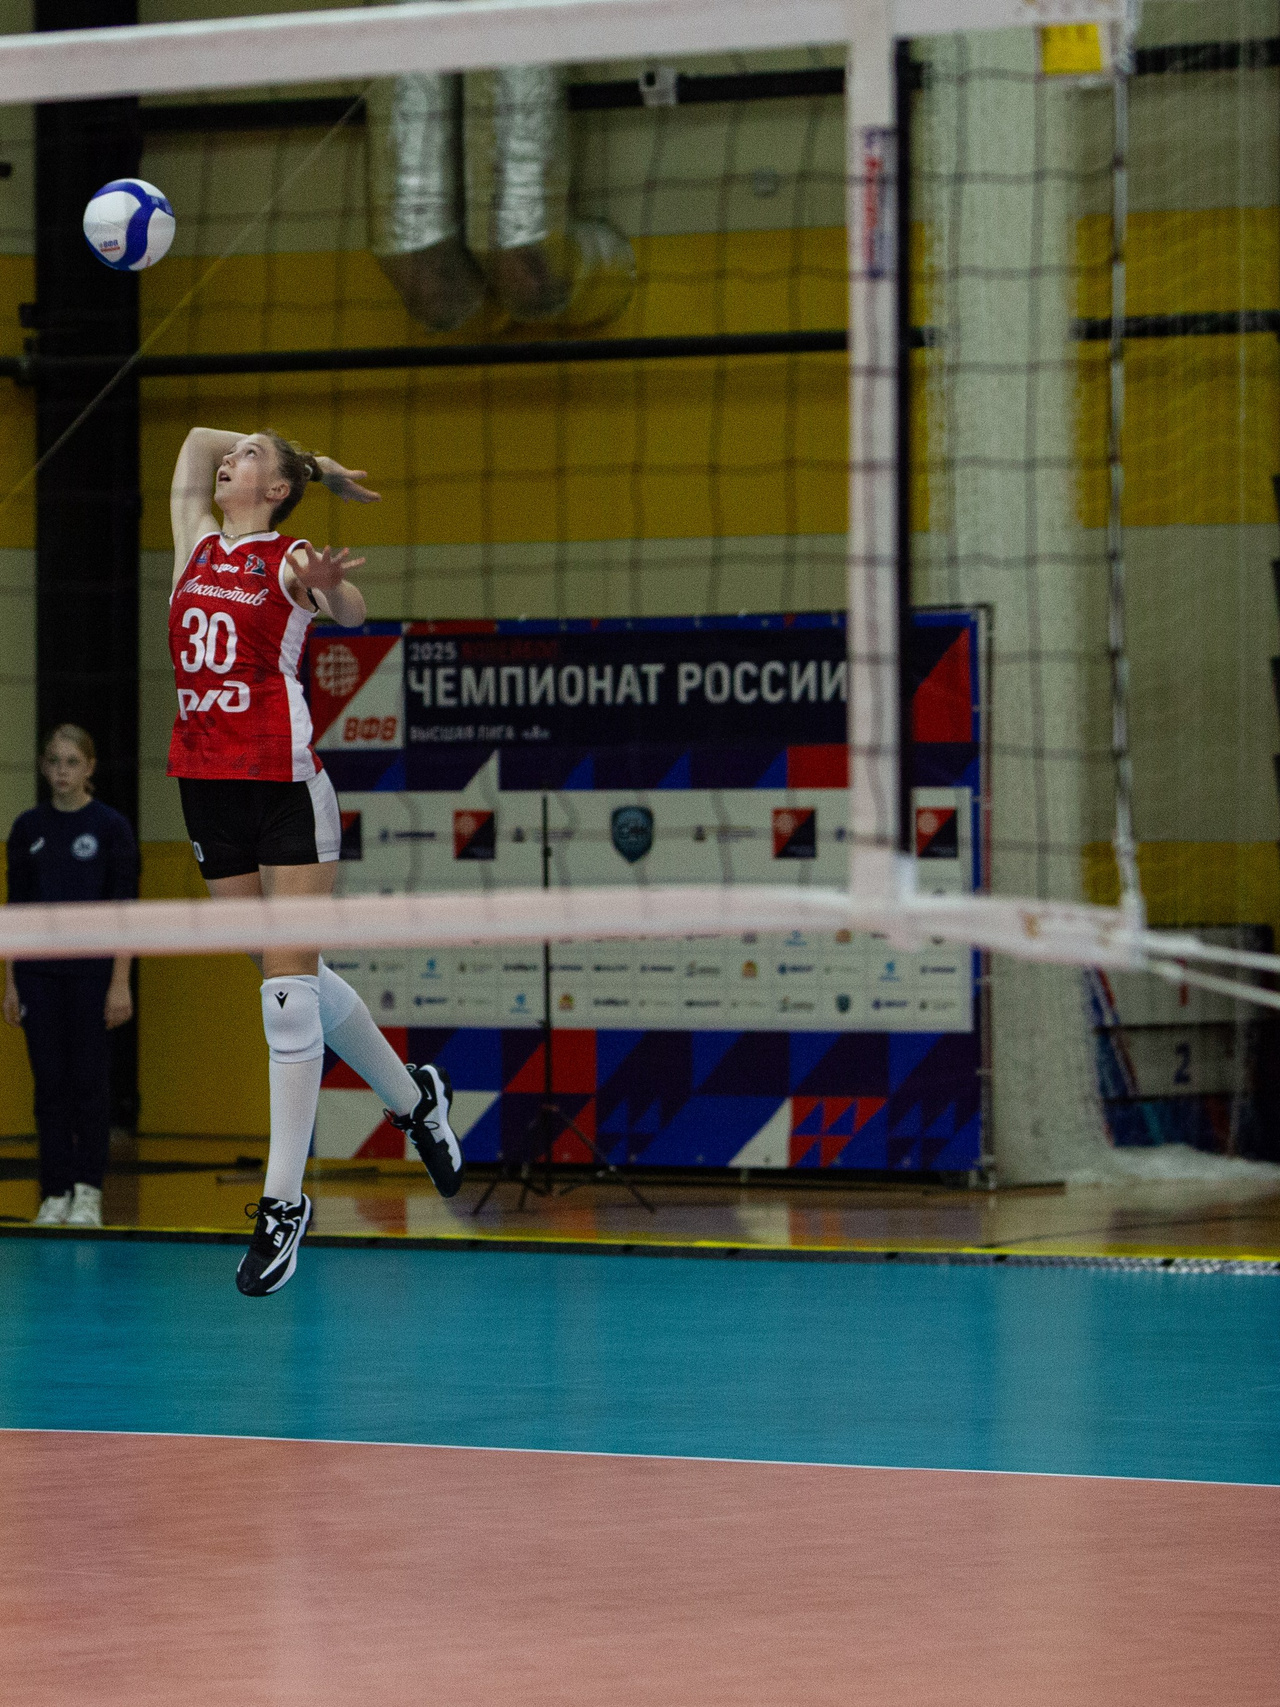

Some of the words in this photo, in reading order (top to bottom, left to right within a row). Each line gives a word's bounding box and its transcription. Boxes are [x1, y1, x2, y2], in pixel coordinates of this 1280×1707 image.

[181, 607, 238, 674] 30
[409, 641, 457, 661] 2025
[408, 664, 665, 707] ЧЕМПИОНАТ
[677, 660, 848, 704] РОССИИ
[1173, 1043, 1191, 1085] 2
